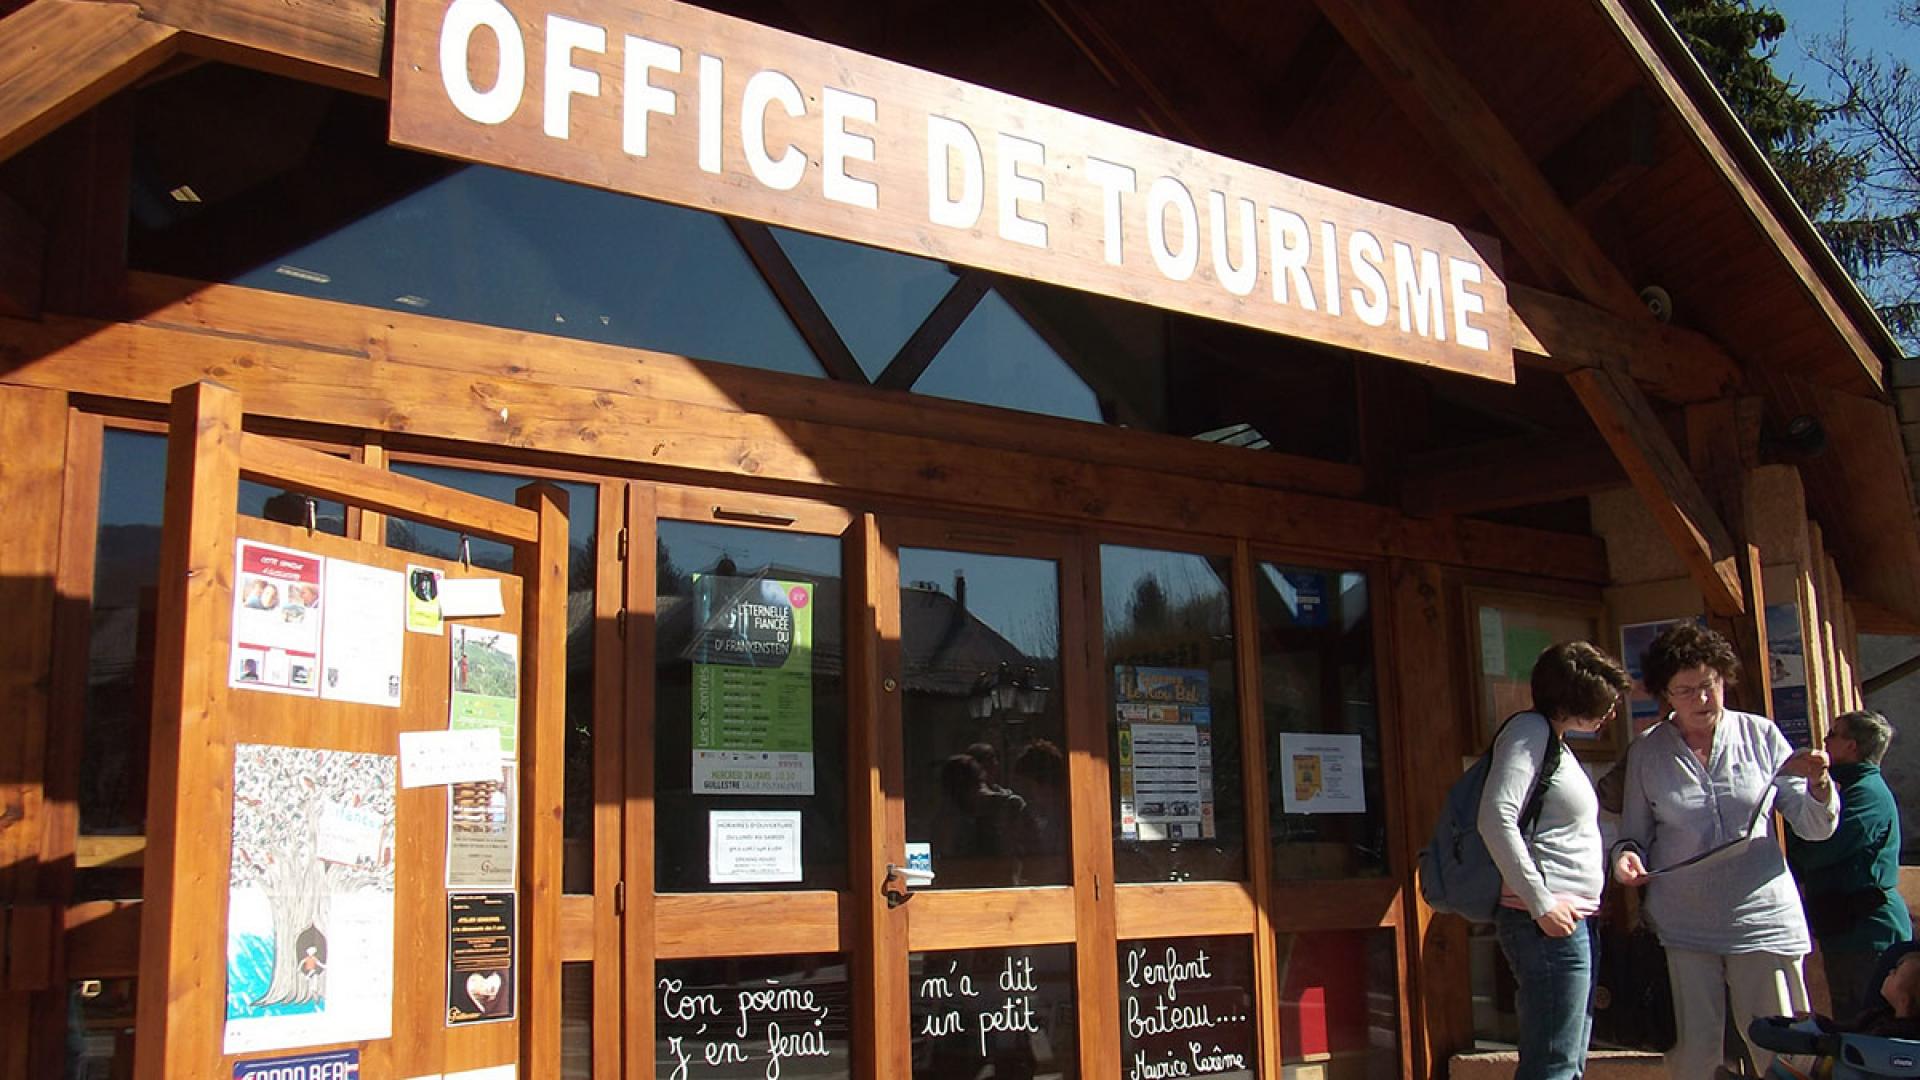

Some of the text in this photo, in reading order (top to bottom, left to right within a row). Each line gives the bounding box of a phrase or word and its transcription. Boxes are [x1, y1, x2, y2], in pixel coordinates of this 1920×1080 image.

[440, 0, 1489, 351] OFFICE DE TOURISME
[658, 978, 722, 1020] Ton
[921, 957, 1037, 998] m'a dit
[1127, 947, 1211, 1000] l'enfant
[667, 1019, 829, 1080] J'en ferai
[922, 997, 1039, 1057] un petit
[1130, 1049, 1190, 1080] Maurice
